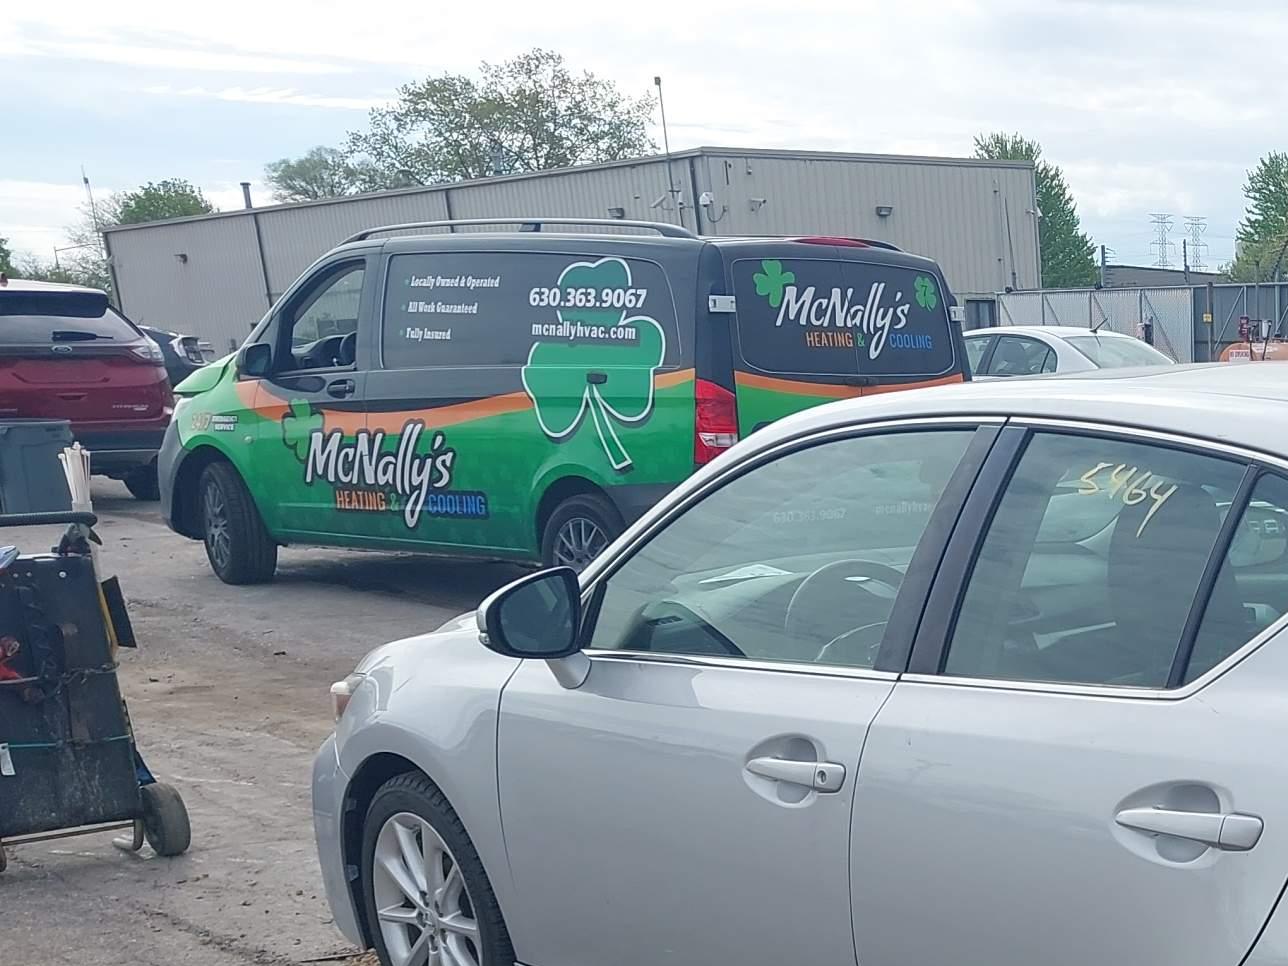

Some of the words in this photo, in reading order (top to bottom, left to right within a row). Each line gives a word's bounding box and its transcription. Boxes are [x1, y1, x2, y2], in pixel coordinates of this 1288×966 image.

[410, 275, 435, 290] Locally
[435, 275, 460, 287] Owned
[460, 276, 466, 287] &
[466, 275, 501, 290] Operated
[407, 301, 418, 313] All
[418, 301, 436, 313] Work
[436, 301, 479, 314] Guaranteed
[528, 287, 648, 308] 630.363.9067
[531, 321, 637, 340] mcnallyhvac.com
[775, 282, 910, 360] McNally's
[405, 327, 423, 342] Fully
[423, 327, 452, 340] Insured
[806, 331, 854, 347] HEATING
[856, 332, 865, 347] &
[889, 333, 933, 349] COOLING
[305, 423, 454, 528] McNally's
[335, 490, 386, 511] HEATING
[389, 492, 400, 511] &
[428, 494, 487, 515] COOLING
[1078, 462, 1179, 538] 5464
